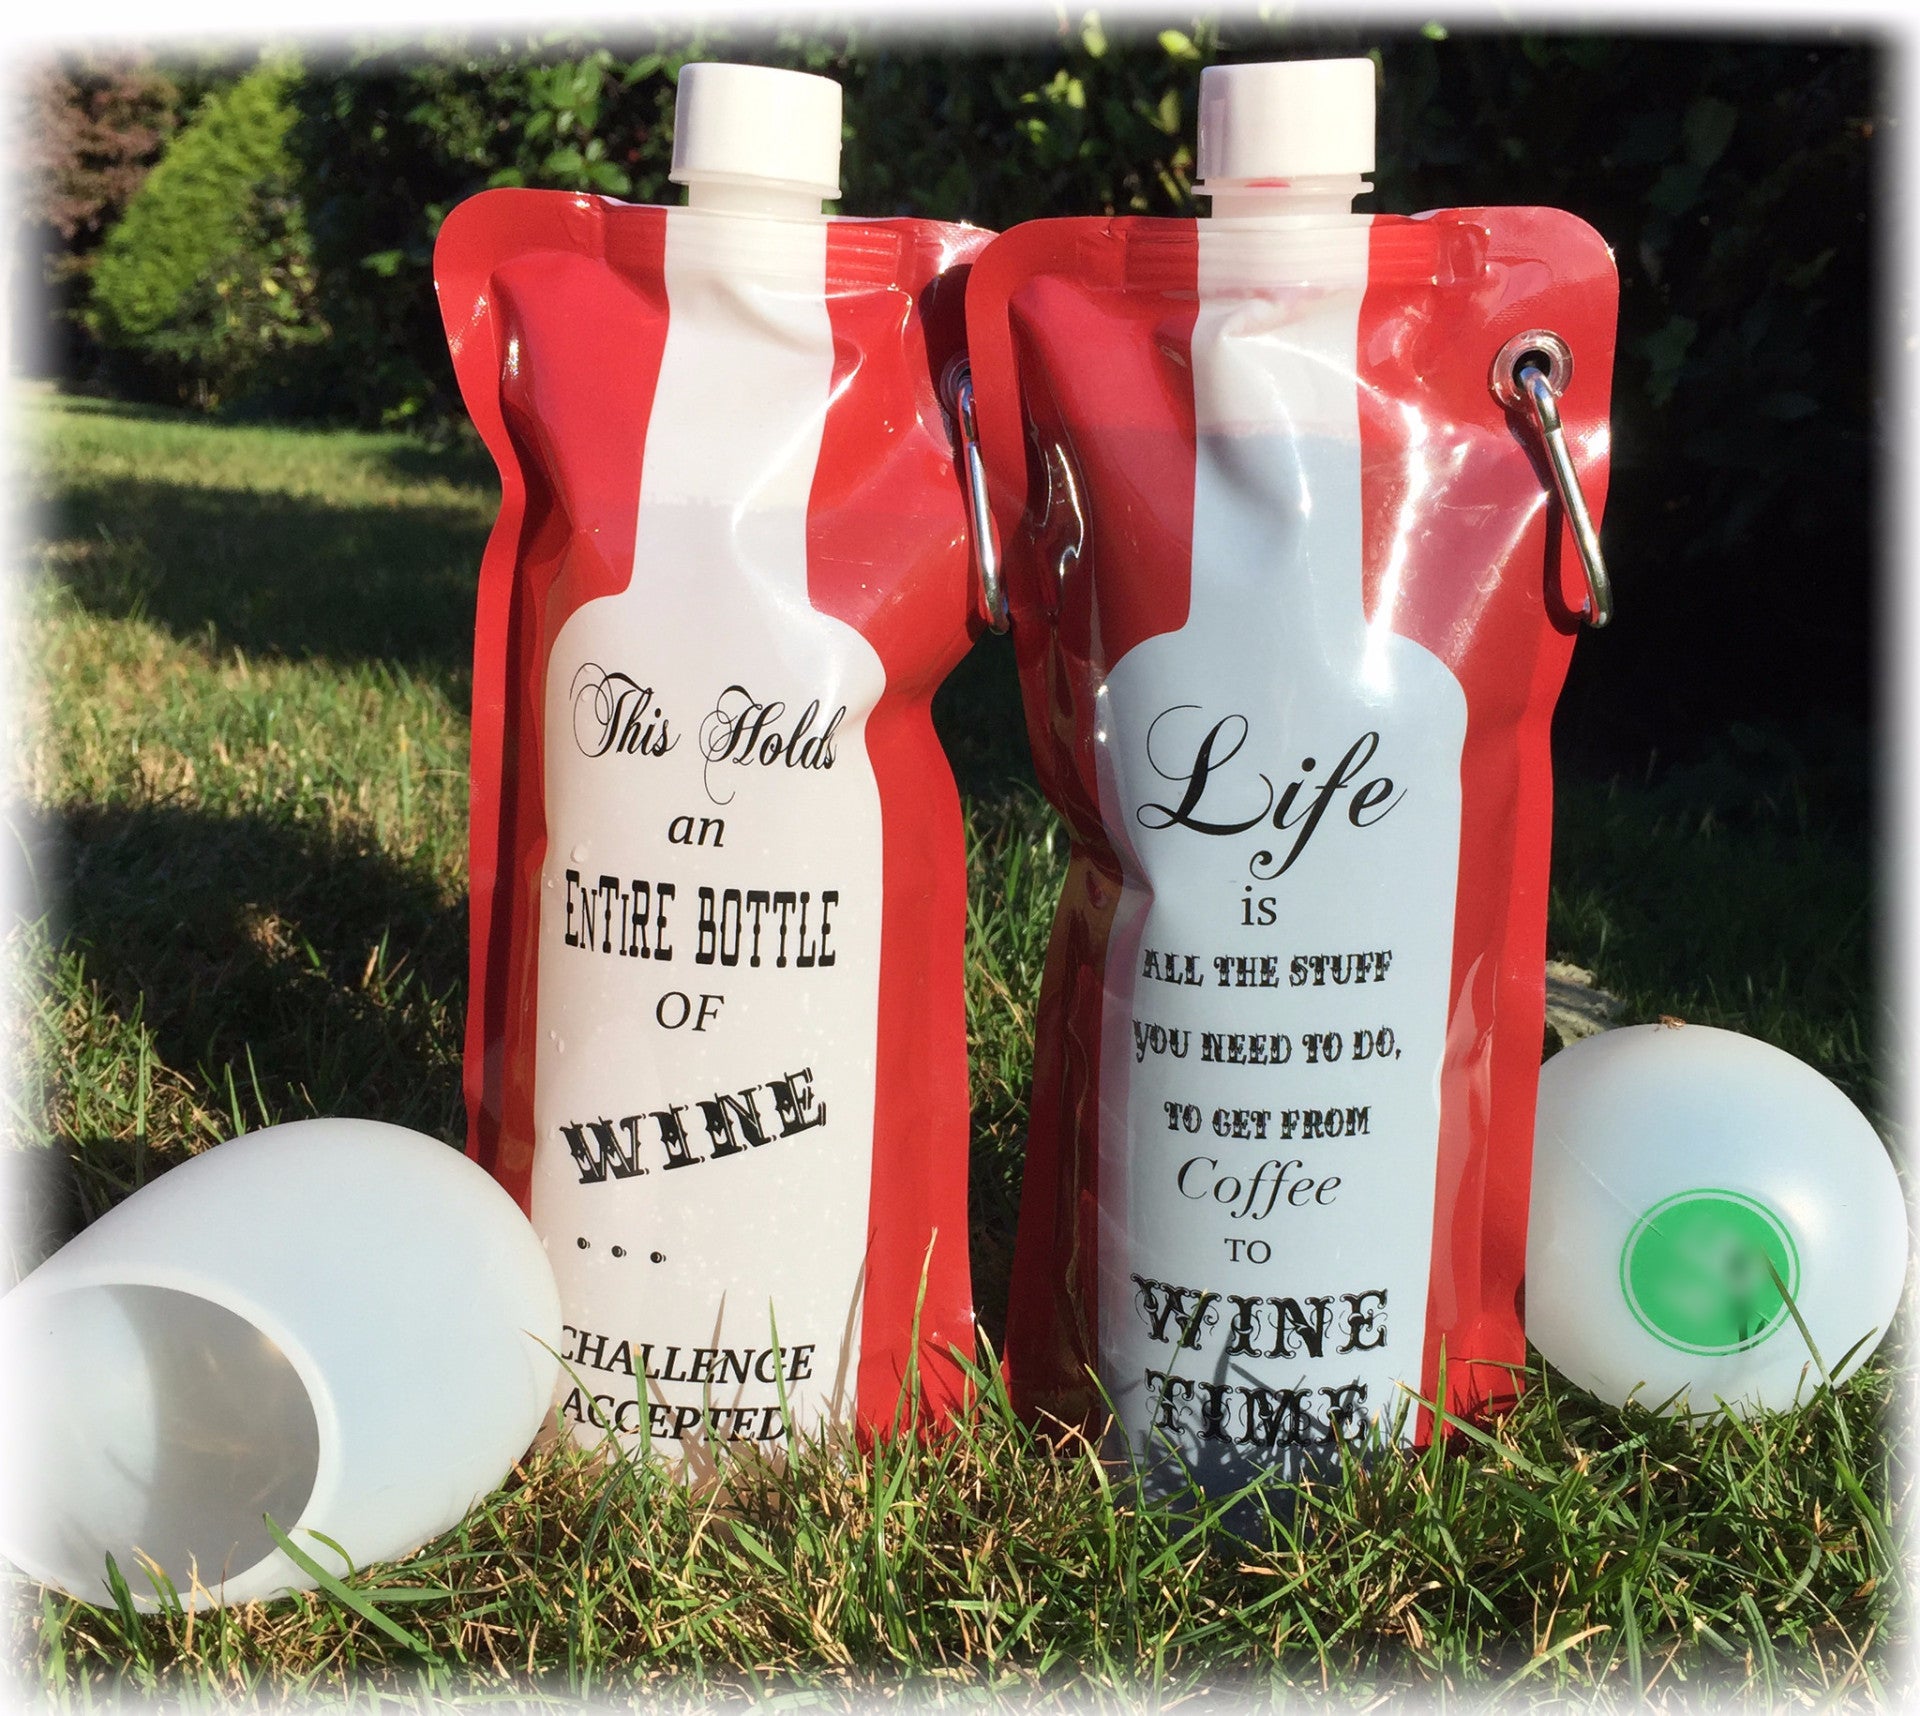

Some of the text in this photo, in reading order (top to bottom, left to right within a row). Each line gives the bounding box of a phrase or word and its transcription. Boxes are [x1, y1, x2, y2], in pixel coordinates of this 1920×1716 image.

[569, 662, 847, 806] This Holds
[1136, 704, 1408, 881] Life
[667, 813, 726, 848] an
[695, 886, 839, 968] BOTTLE
[1240, 885, 1278, 926] is
[1141, 948, 1393, 988] ALL THE STUFF
[655, 991, 725, 1033] OF
[1200, 1031, 1293, 1065] NEED
[1302, 1030, 1344, 1064] TO
[1351, 1025, 1402, 1062] DO,
[559, 1067, 826, 1185] WINE
[1163, 1101, 1372, 1141] TO GET FROM
[1177, 1156, 1342, 1221] Coffee
[1223, 1237, 1272, 1265] TO
[1130, 1272, 1388, 1361] WINE
[561, 1324, 816, 1385] CHALLENGE
[562, 1387, 789, 1443] ACCEPTED
[1143, 1367, 1370, 1448] TIME
